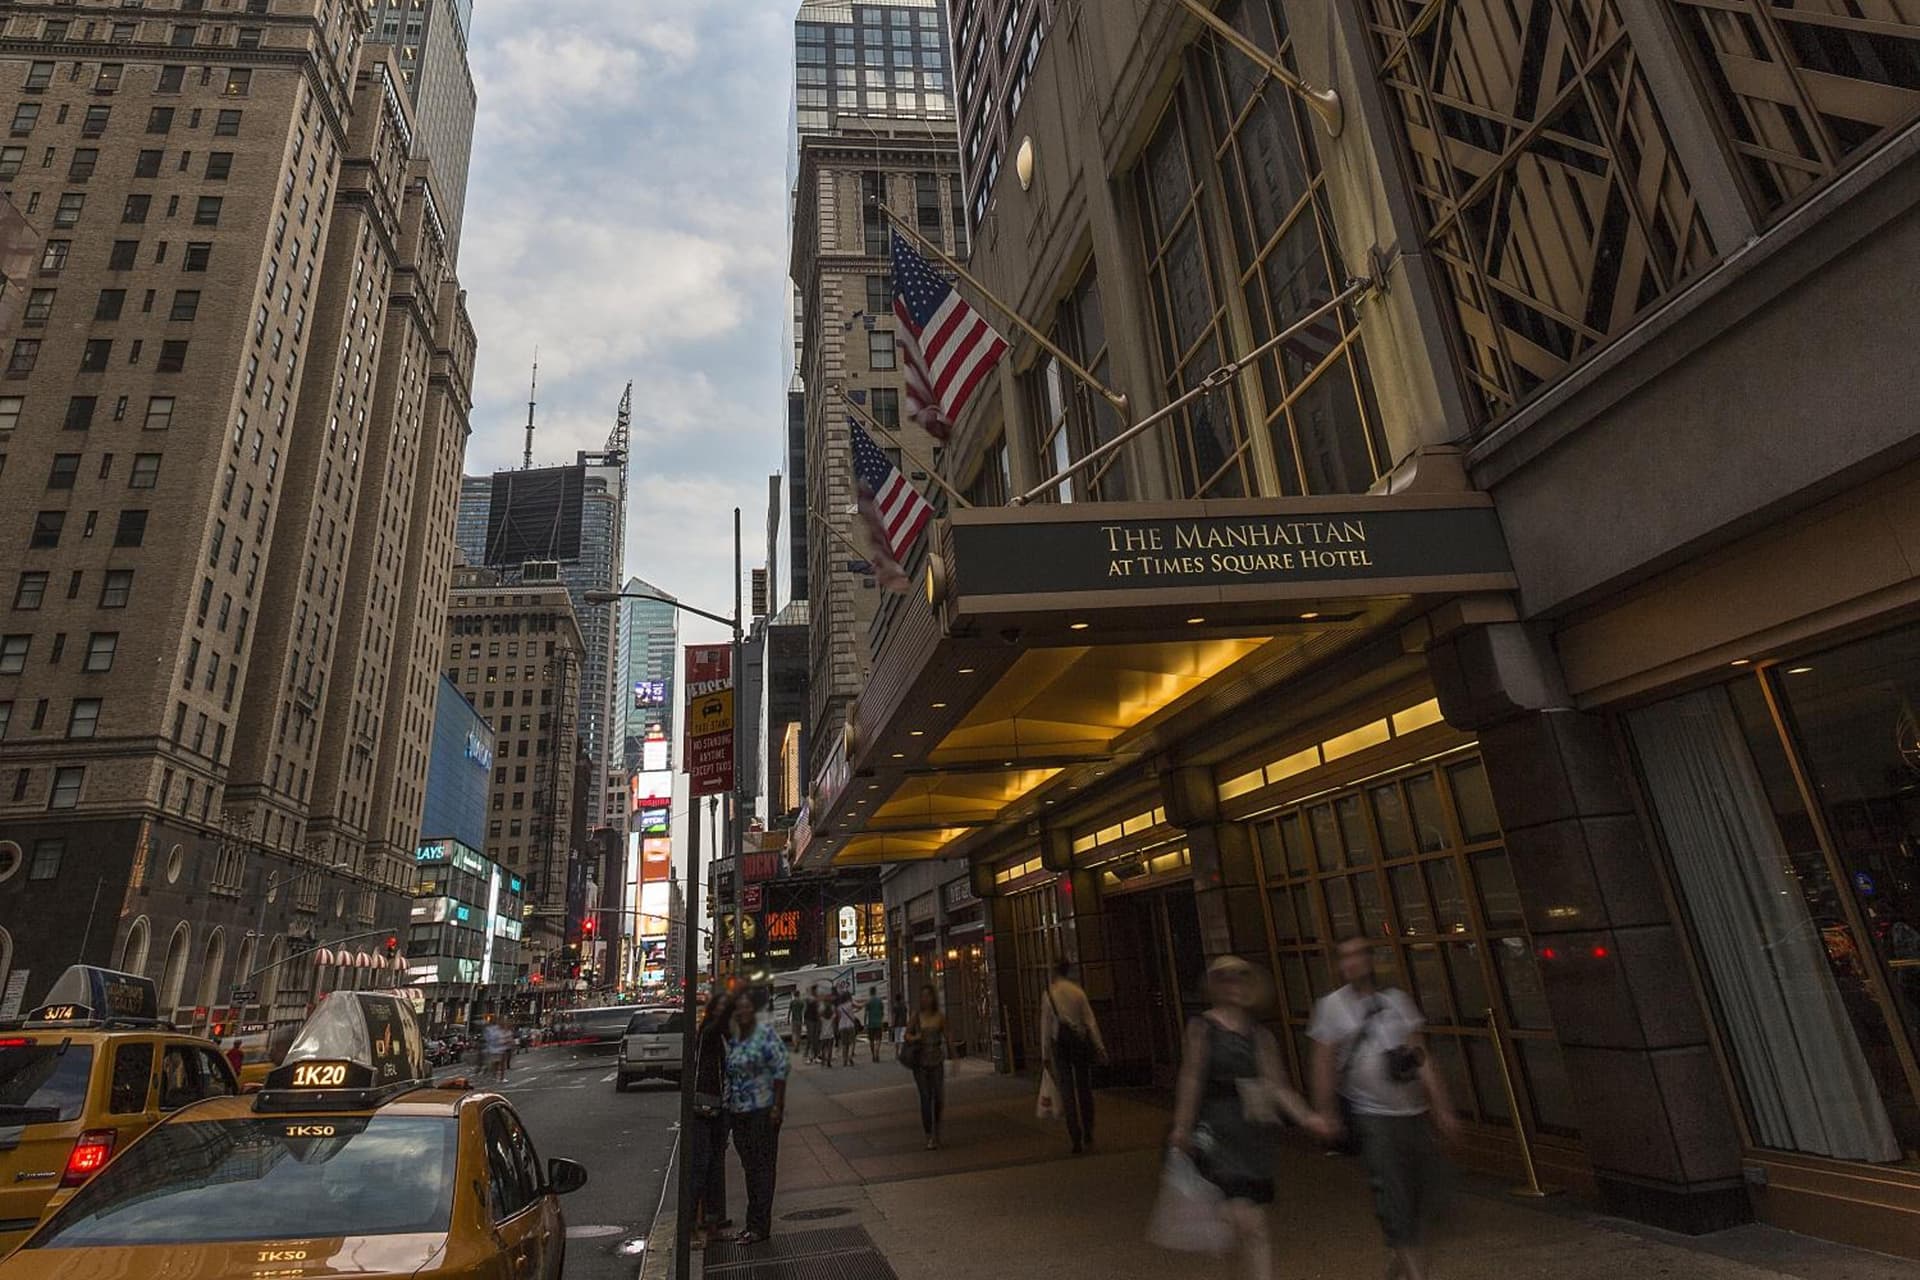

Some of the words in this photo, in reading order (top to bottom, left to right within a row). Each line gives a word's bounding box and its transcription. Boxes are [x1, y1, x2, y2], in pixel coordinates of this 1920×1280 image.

[1101, 525, 1163, 552] THE
[1175, 520, 1366, 550] MANHATTAN
[1108, 559, 1134, 577] AT
[1137, 556, 1205, 575] TIMES
[1210, 552, 1295, 575] SQUARE
[1299, 549, 1373, 568] HOTEL
[639, 798, 670, 808] TOSHIBA
[44, 1006, 74, 1020] 3J74
[292, 1065, 347, 1086] 1K20
